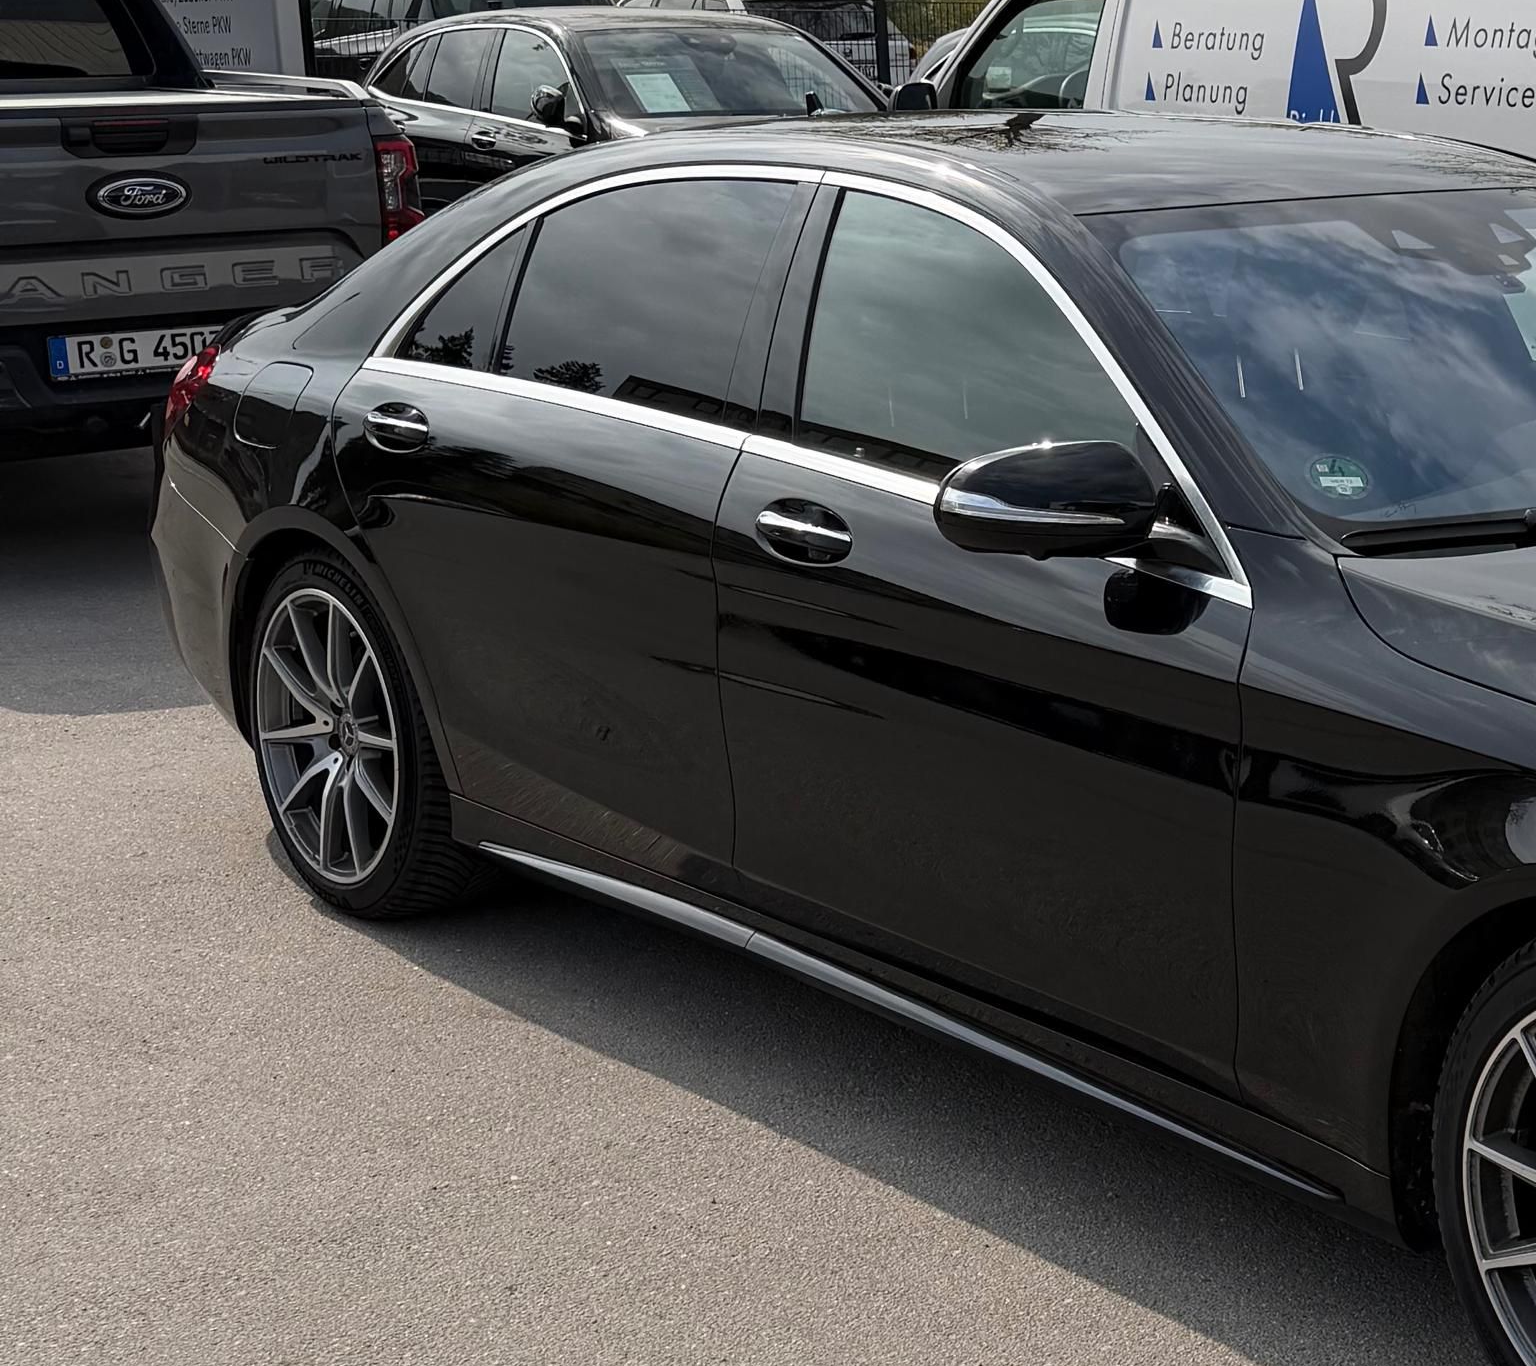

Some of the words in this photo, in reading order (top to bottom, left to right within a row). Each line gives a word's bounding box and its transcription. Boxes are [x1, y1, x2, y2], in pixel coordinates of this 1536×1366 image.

[183, 15, 210, 35] Sterne
[212, 15, 231, 33] PKW
[1170, 21, 1266, 60] Beratung
[231, 47, 251, 66] PKW
[1163, 72, 1248, 114] Planung
[1438, 73, 1536, 108] Service
[120, 186, 167, 206] Ford
[77, 340, 98, 369] R
[118, 337, 139, 365] G
[153, 330, 220, 362] 450
[56, 360, 64, 370] D
